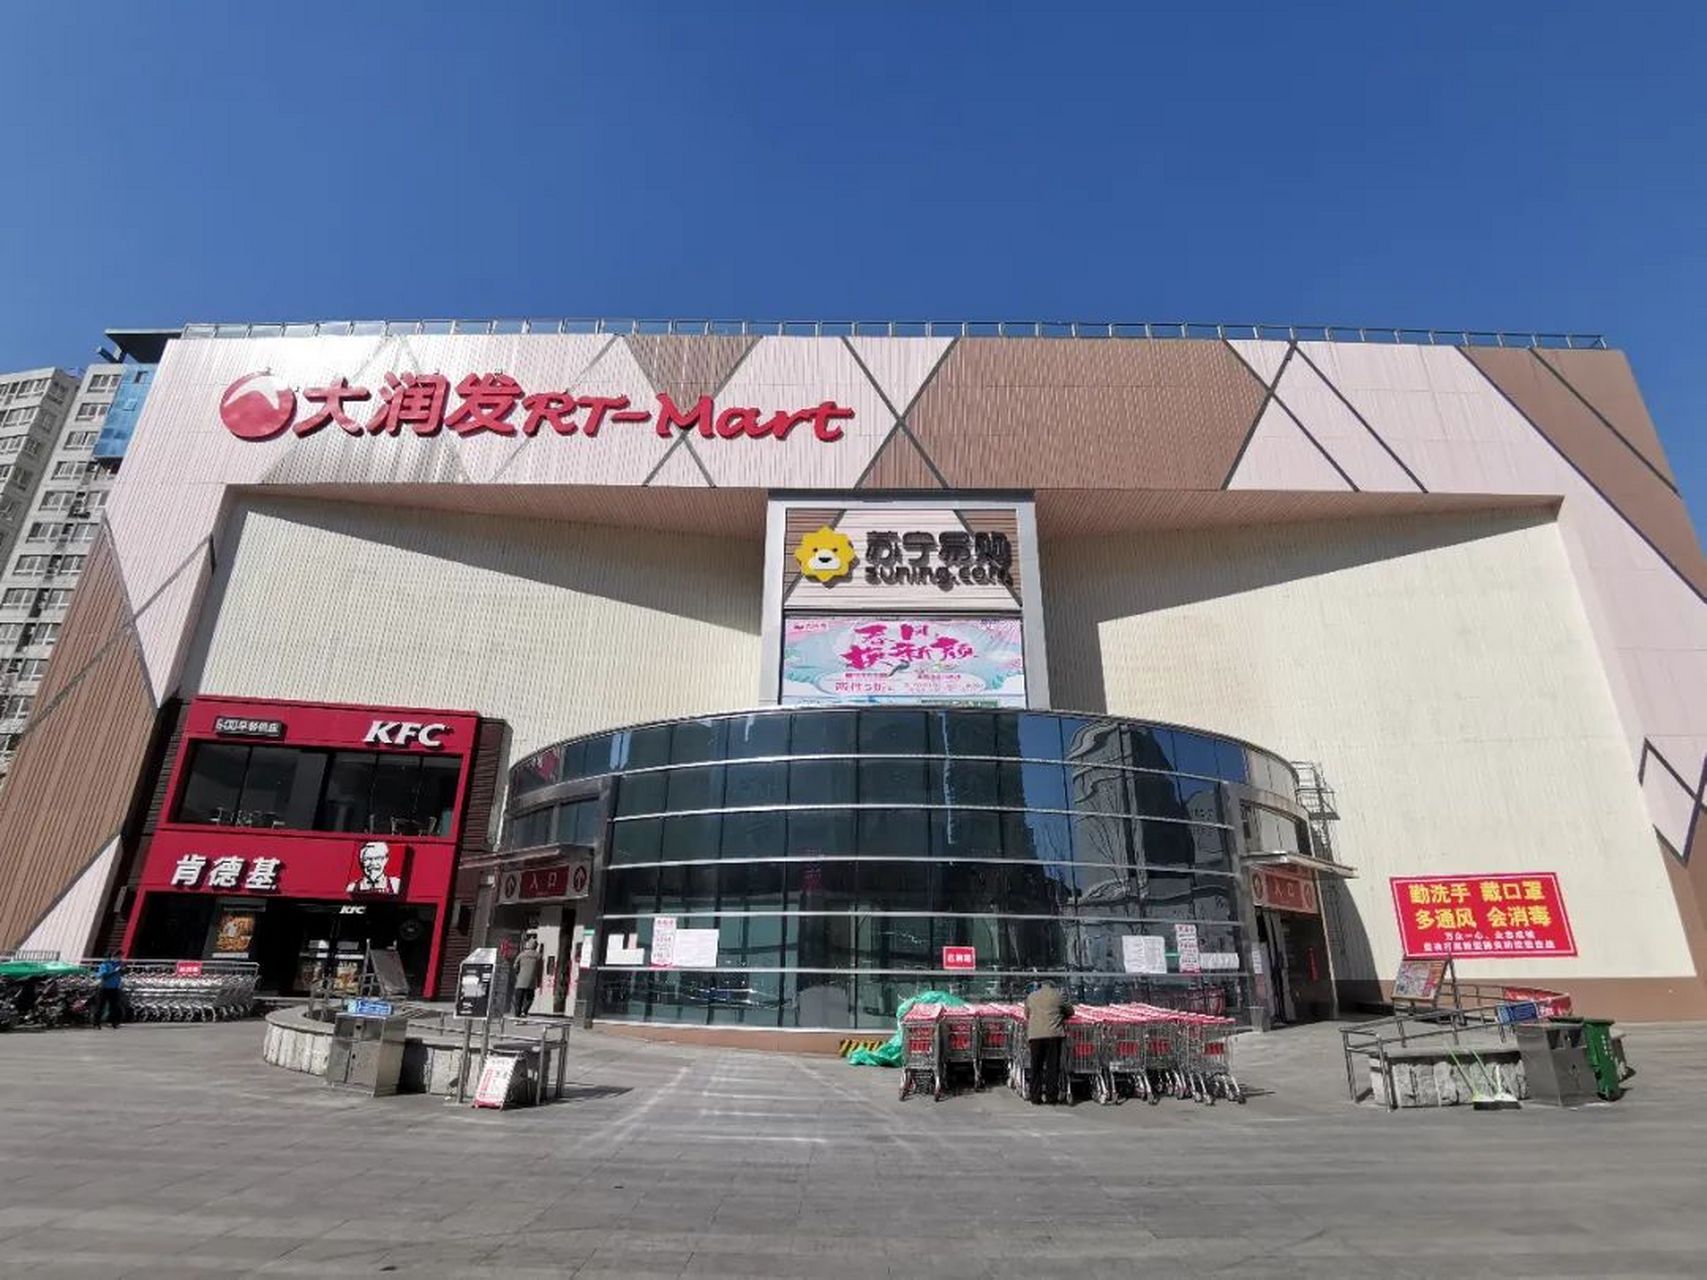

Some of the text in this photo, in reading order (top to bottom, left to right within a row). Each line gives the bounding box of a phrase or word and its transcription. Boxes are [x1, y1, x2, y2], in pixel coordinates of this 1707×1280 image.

[294, 371, 855, 442] 大润发 RT-Mart
[363, 720, 447, 747] KFC
[171, 853, 281, 889] 肯德基
[1408, 880, 1545, 903] 勤洗手 戴口罩
[339, 905, 367, 914] KFC
[1415, 905, 1552, 930] 多通风 会消毒
